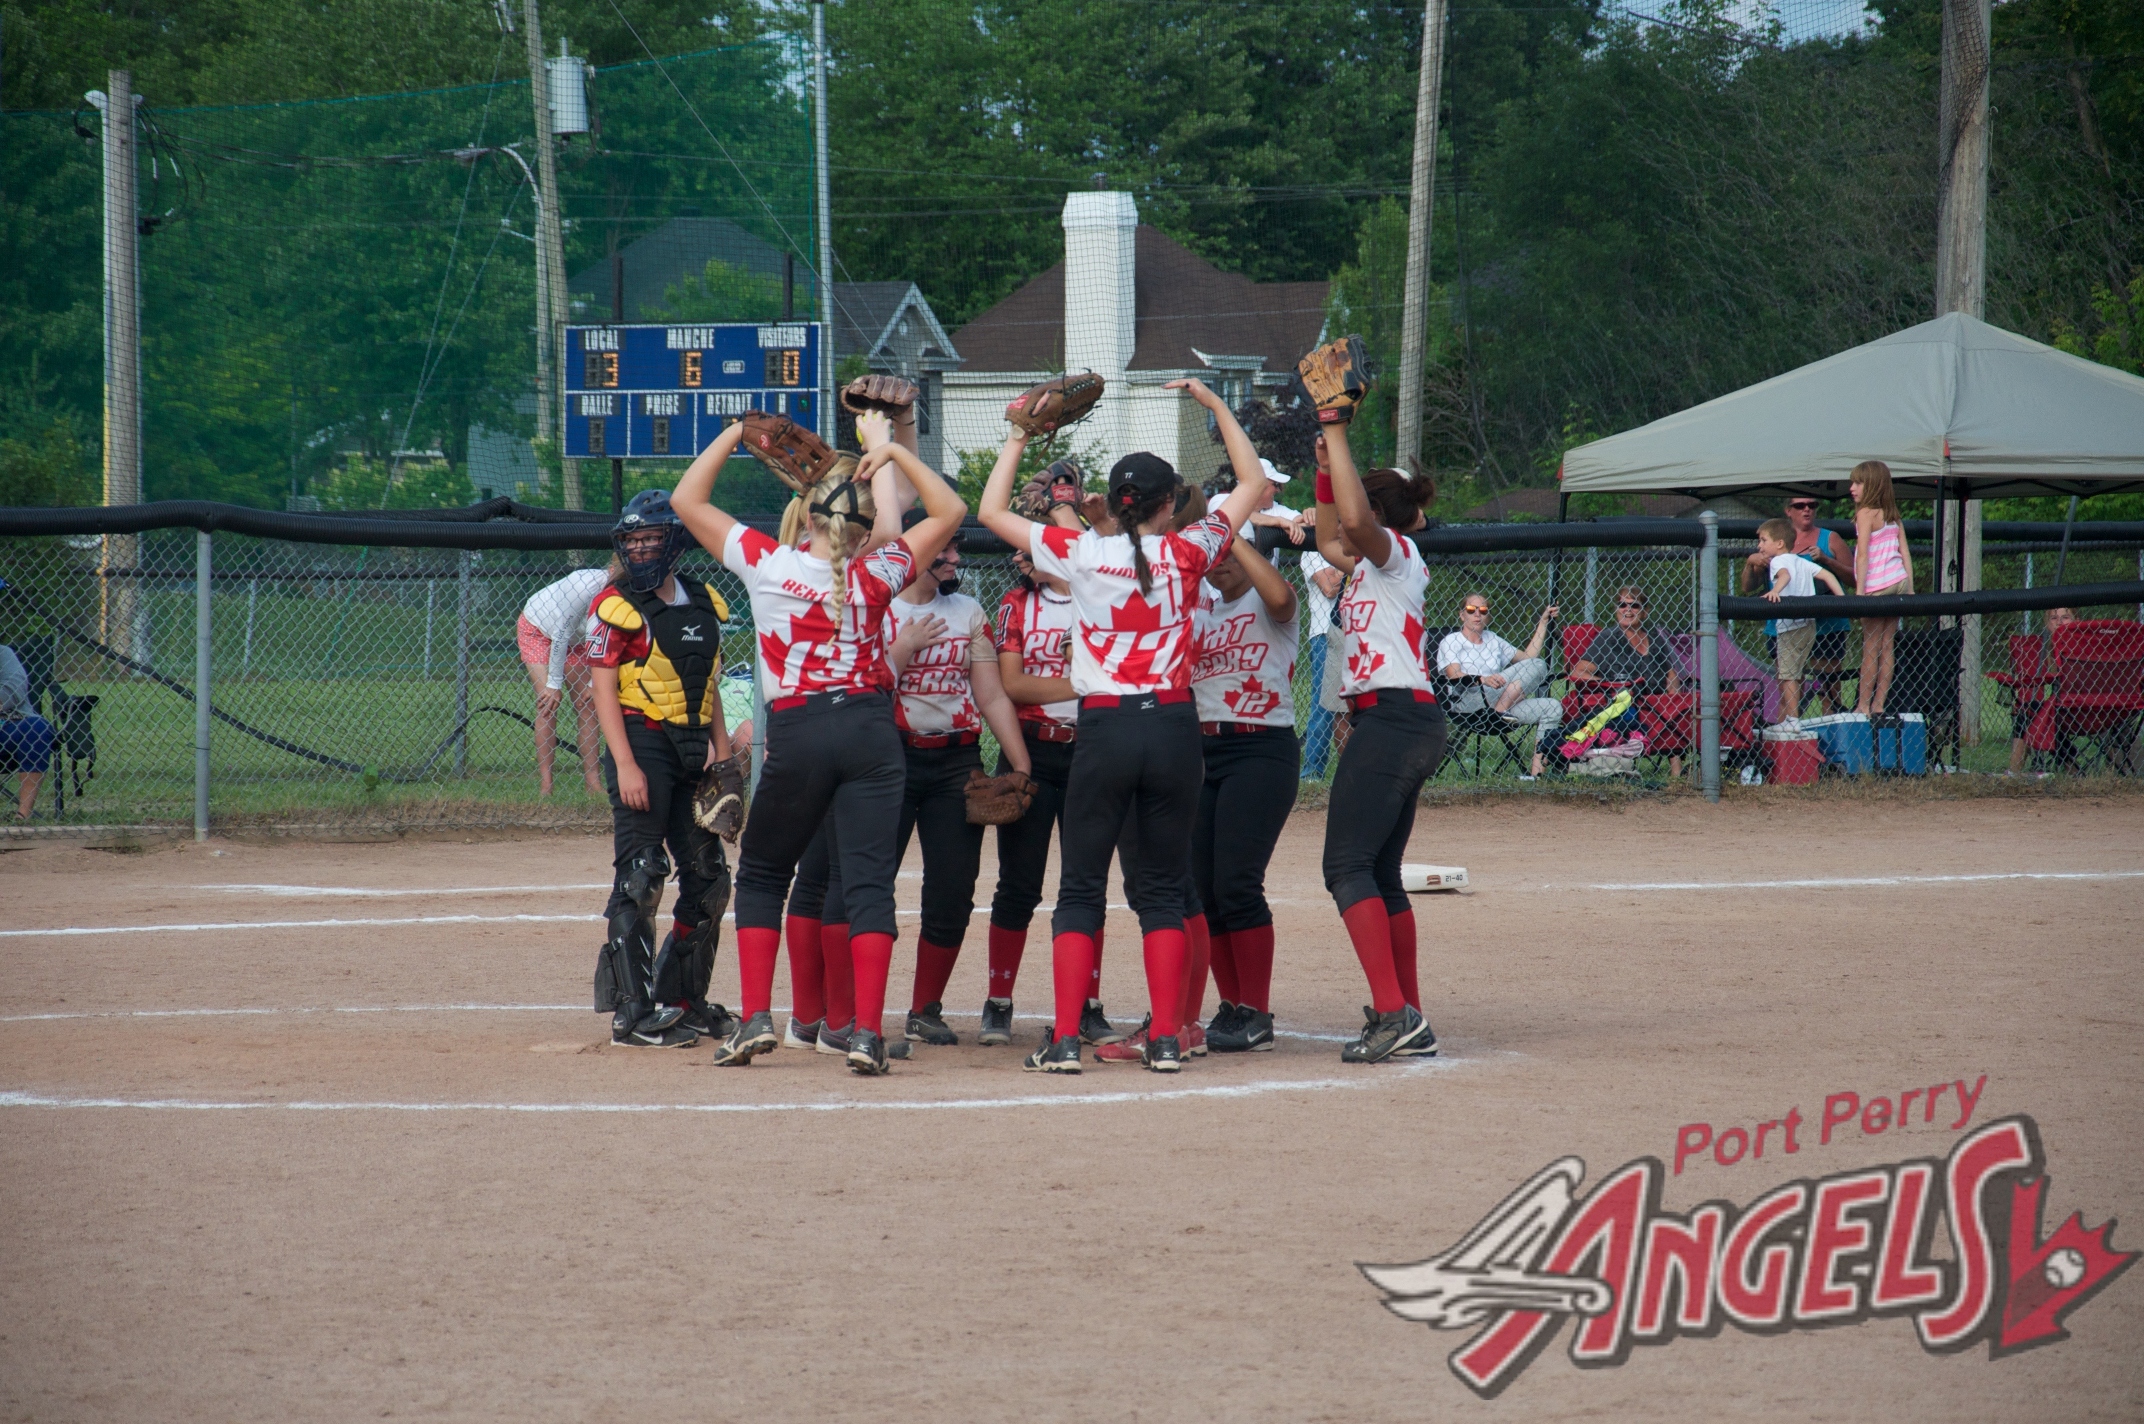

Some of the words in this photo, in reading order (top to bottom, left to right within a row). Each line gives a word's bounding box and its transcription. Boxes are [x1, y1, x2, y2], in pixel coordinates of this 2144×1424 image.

[585, 330, 619, 350] LOCAL
[667, 328, 715, 349] MANCHE
[757, 327, 806, 348] VISITEURS
[602, 352, 619, 387] 3
[685, 351, 702, 387] 6
[782, 350, 800, 386] 0
[581, 394, 613, 415] BALLE
[645, 394, 679, 415] PRISE
[706, 393, 752, 415] RETRAIT
[1124, 471, 1134, 479] 77
[1088, 623, 1186, 675] 77
[1231, 690, 1271, 714] 12
